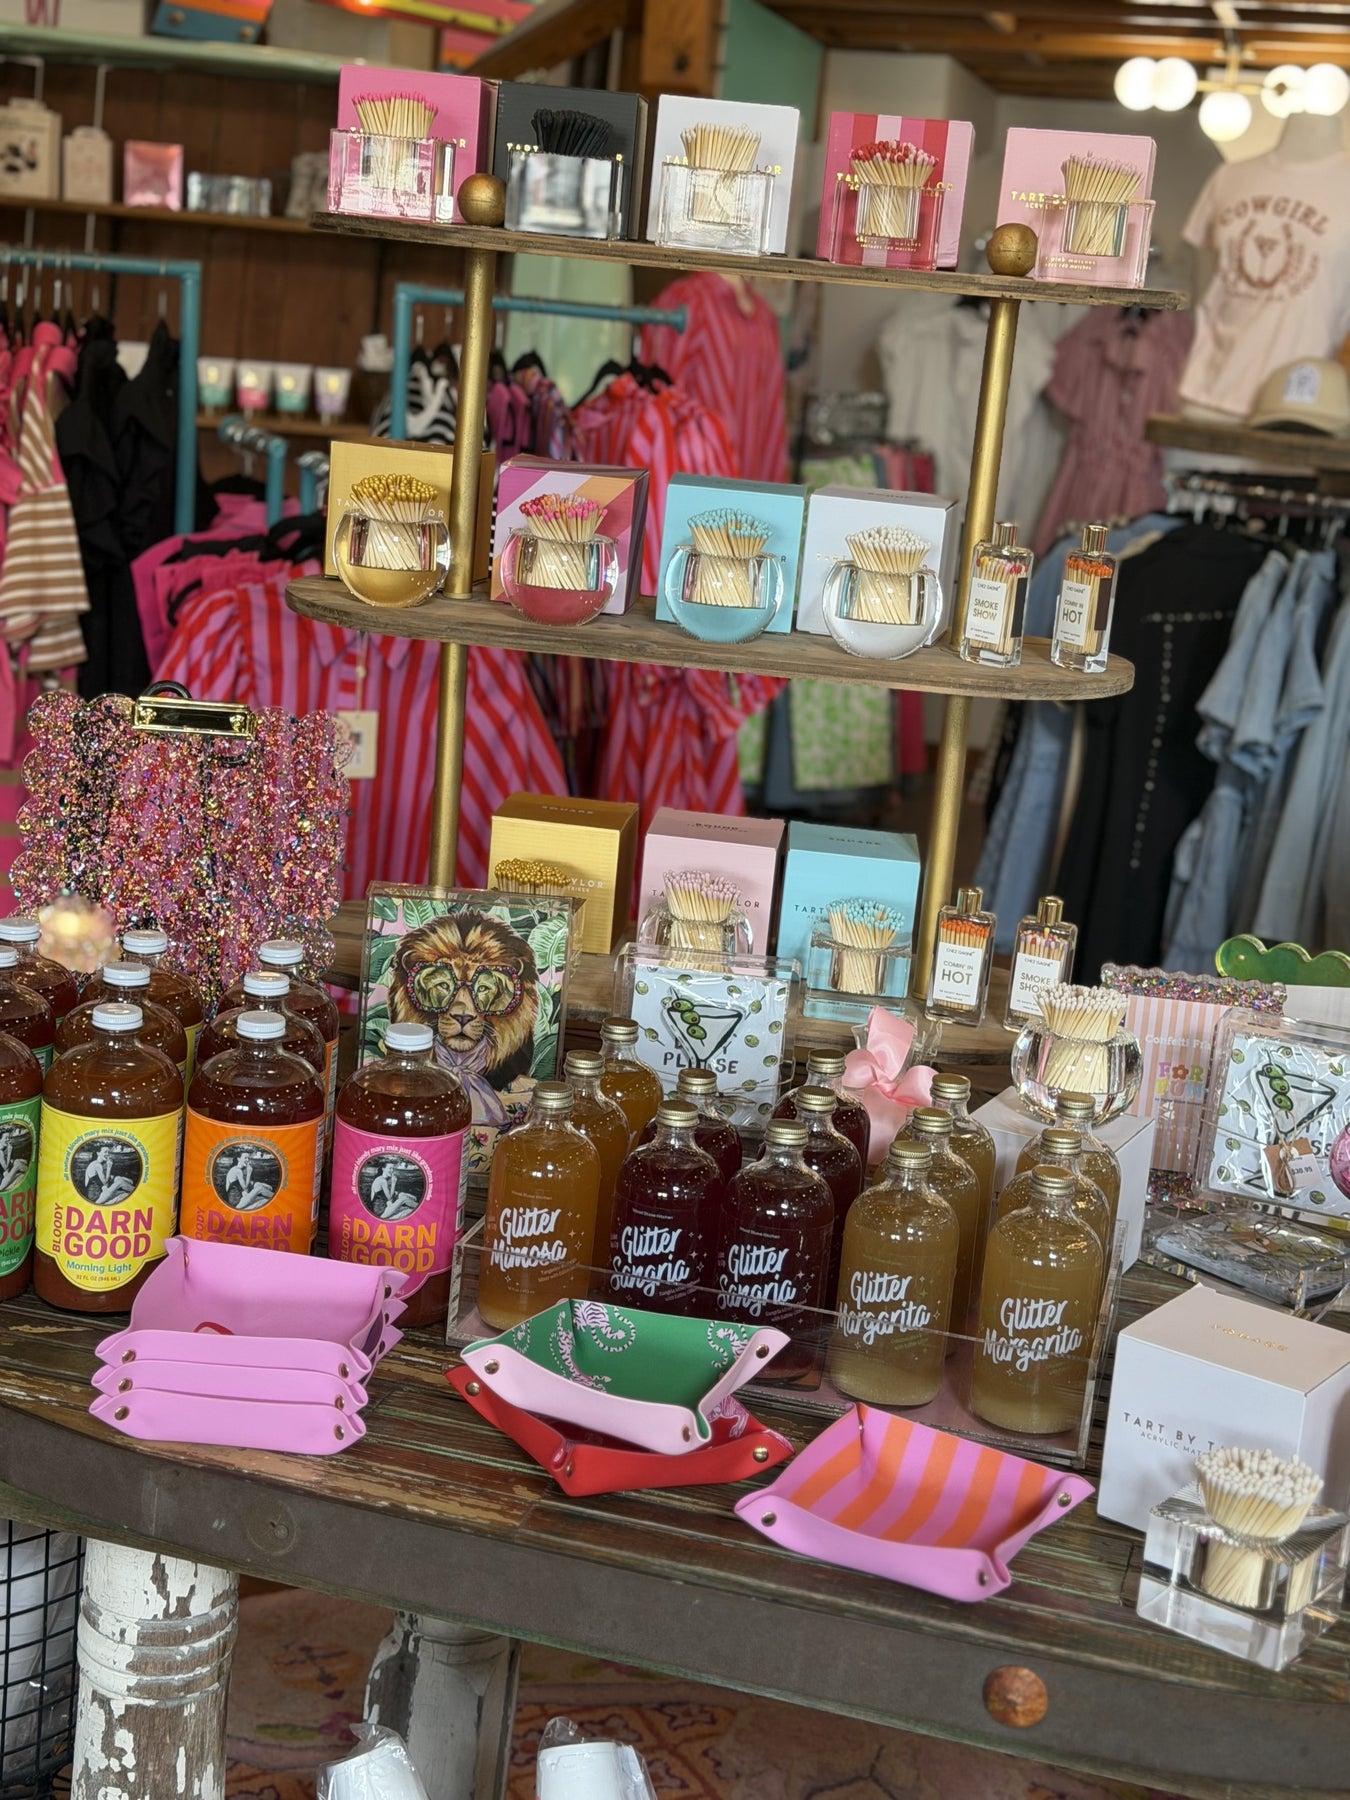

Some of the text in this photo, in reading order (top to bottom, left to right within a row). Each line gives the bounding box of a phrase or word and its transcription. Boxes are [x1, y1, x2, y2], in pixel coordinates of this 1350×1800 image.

[1216, 195, 1329, 237] COWGIRL
[972, 608, 998, 621] SHOW
[974, 598, 999, 611] SMOKE
[1062, 607, 1083, 625] HOT
[571, 878, 604, 889] YLOR
[794, 904, 825, 914] TART
[941, 968, 973, 985] HOT
[1020, 972, 1052, 986] SMOKE
[68, 1134, 84, 1152] bloody
[83, 1130, 100, 1139] mary
[114, 1128, 128, 1137] just
[127, 1132, 138, 1143] like
[355, 1149, 371, 1166] bloody
[370, 1145, 386, 1154] mary
[386, 1144, 399, 1152] mix
[398, 1145, 413, 1155] just
[411, 1150, 422, 1161] like
[1291, 1166, 1313, 1175] $30.95
[52, 1202, 64, 1253] BLOODY
[65, 1206, 154, 1235] DARN
[195, 1205, 206, 1240] OODY
[207, 1209, 293, 1241] DARN
[352, 1218, 438, 1249] DARN
[500, 1207, 562, 1246] Glitter
[63, 1231, 152, 1260] GOOD
[351, 1243, 435, 1274] GOOD
[490, 1238, 568, 1272] Mimosa
[621, 1225, 683, 1264] Glitter
[66, 1260, 132, 1274] Morning Light
[610, 1253, 690, 1297] Sangria
[728, 1244, 790, 1283] Glitter
[716, 1273, 797, 1317] Sangria
[850, 1271, 913, 1310] Glitter
[837, 1300, 931, 1346] Margarita
[1000, 1297, 1069, 1337] Glitter
[983, 1325, 1083, 1372] Margarita
[1123, 1411, 1196, 1445] TART BY
[1140, 1431, 1179, 1450] ACRYLIC
[1182, 1445, 1203, 1457] MAT
